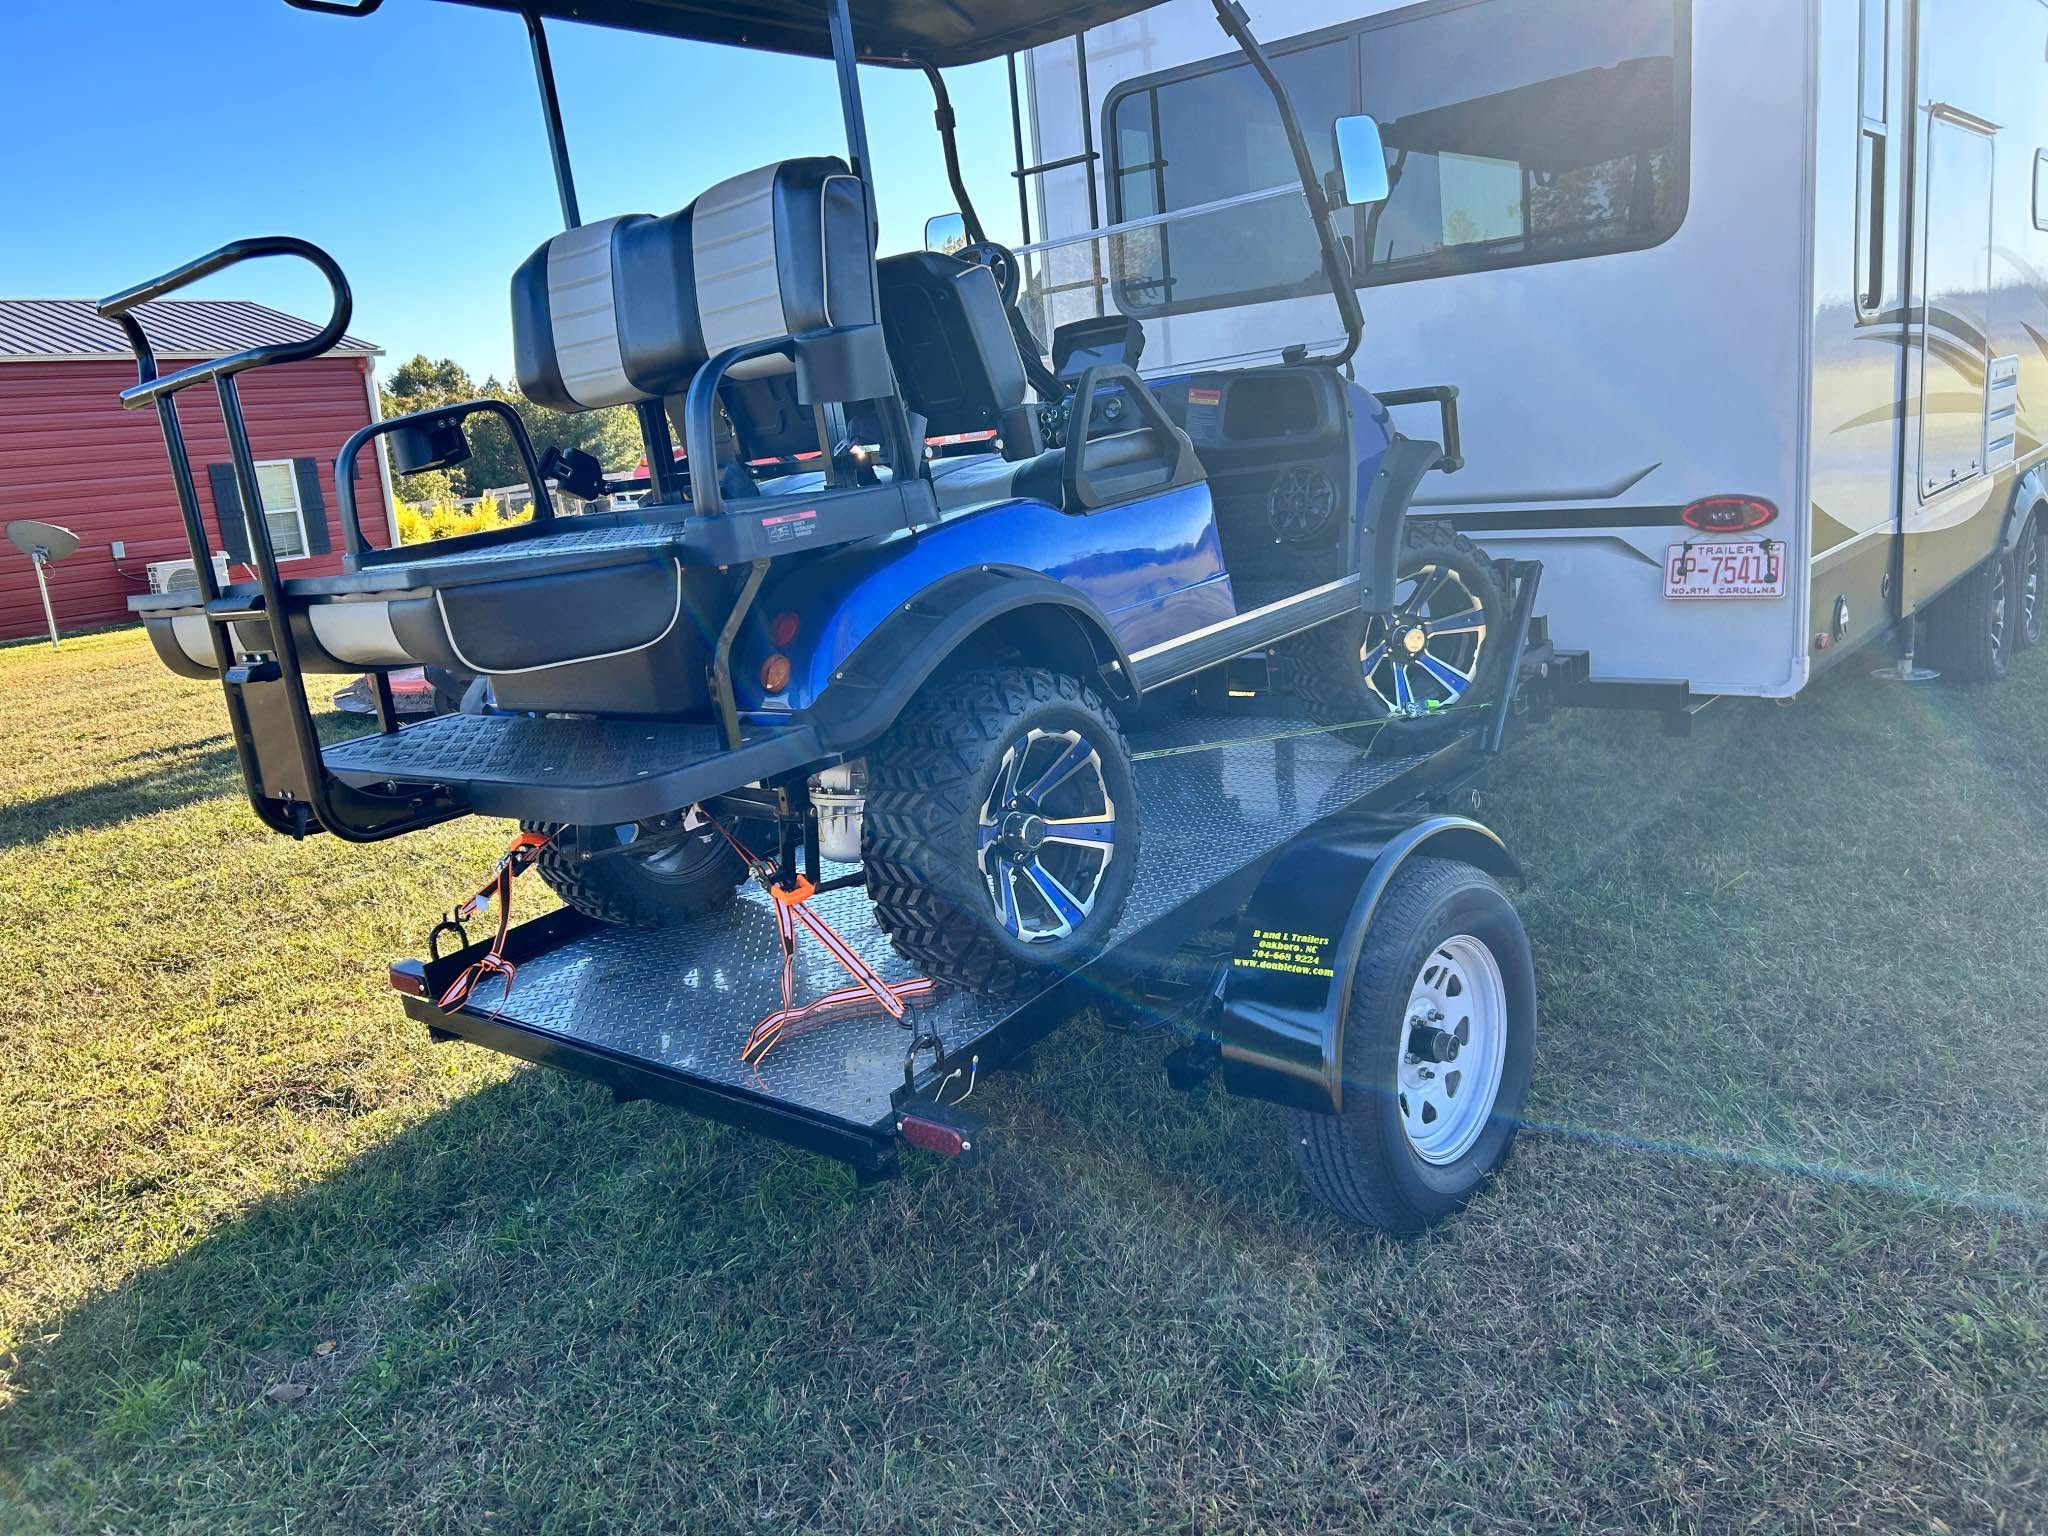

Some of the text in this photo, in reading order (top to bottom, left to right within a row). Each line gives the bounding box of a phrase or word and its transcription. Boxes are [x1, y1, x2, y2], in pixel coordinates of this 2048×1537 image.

[1698, 546, 1754, 555] TRAILER
[1253, 929, 1261, 938] B
[1262, 931, 1281, 940] and
[1291, 934, 1329, 945] Trailers
[1251, 949, 1320, 965] 704-668 9224
[1305, 945, 1319, 954] NC
[1233, 958, 1334, 977] www.doubletow.com
